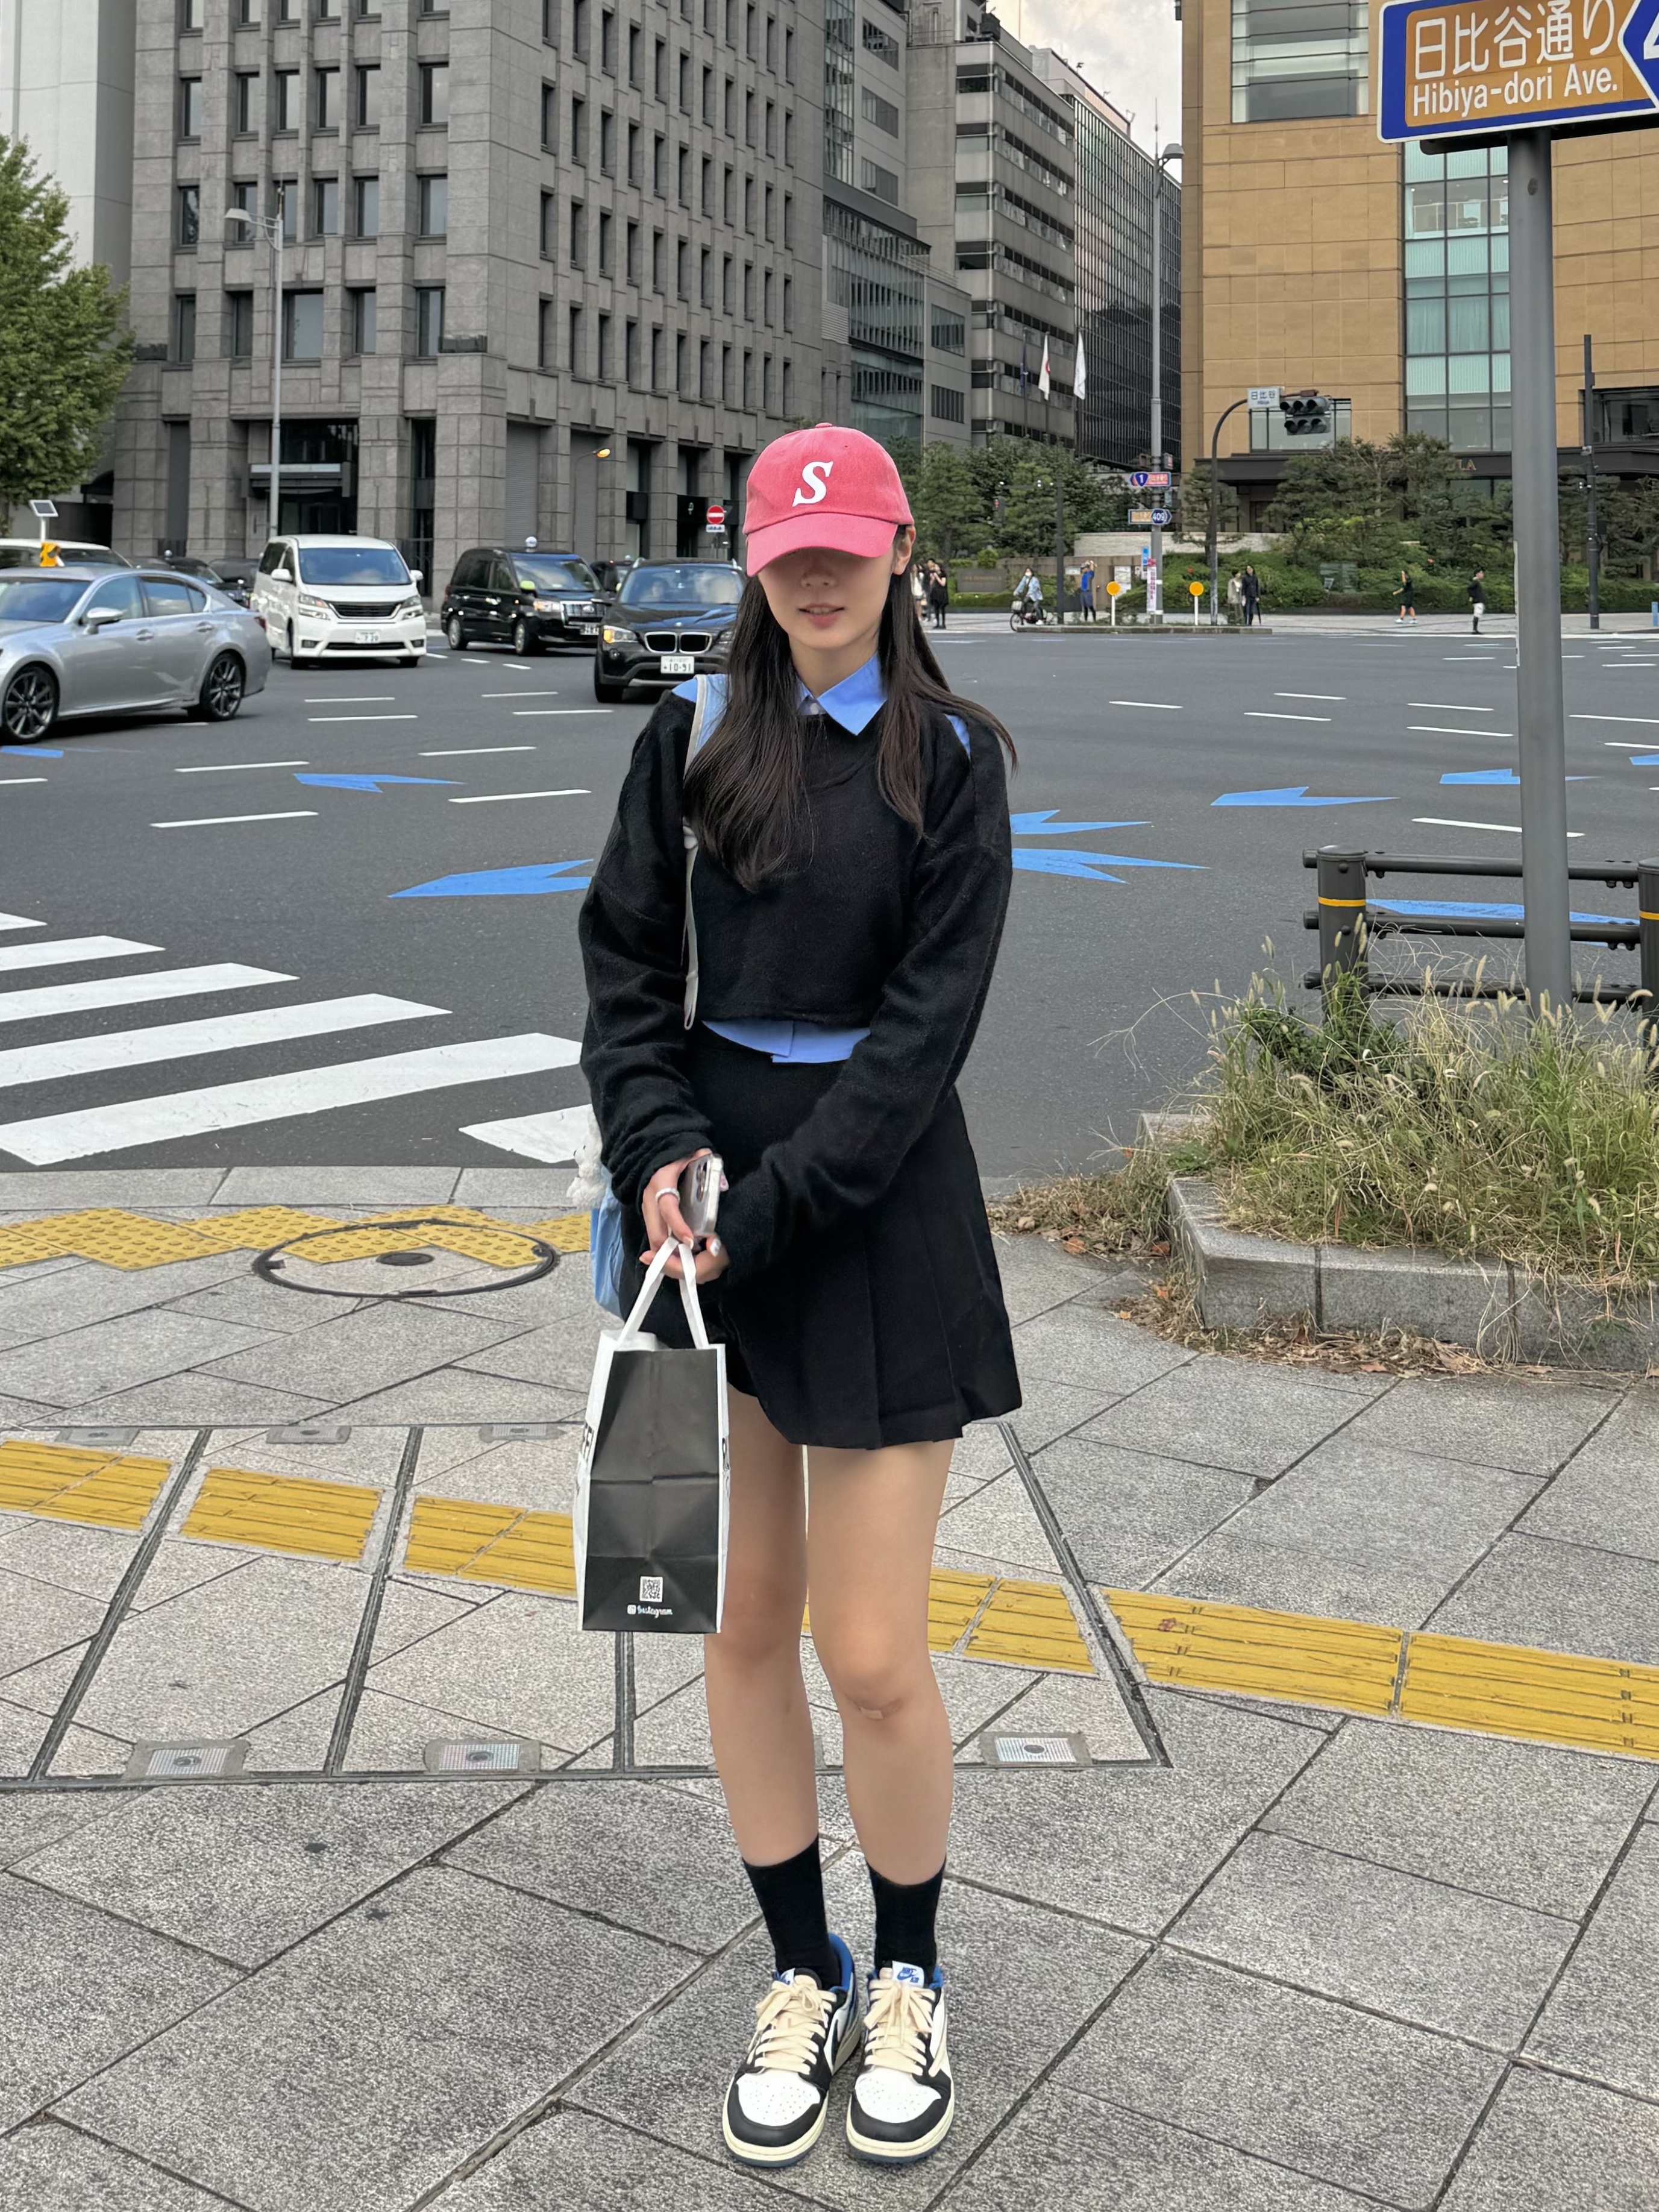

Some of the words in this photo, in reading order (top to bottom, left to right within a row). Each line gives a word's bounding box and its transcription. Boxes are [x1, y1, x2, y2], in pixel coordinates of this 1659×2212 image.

[1415, 0, 1614, 80] 日比谷通り
[1413, 66, 1552, 118] Hibiya-dori
[1563, 63, 1617, 97] Ave.
[1251, 389, 1276, 400] 日比谷
[792, 460, 833, 507] S
[1139, 474, 1144, 483] 1
[1152, 512, 1165, 521] 409
[637, 1605, 673, 1618] Instagram
